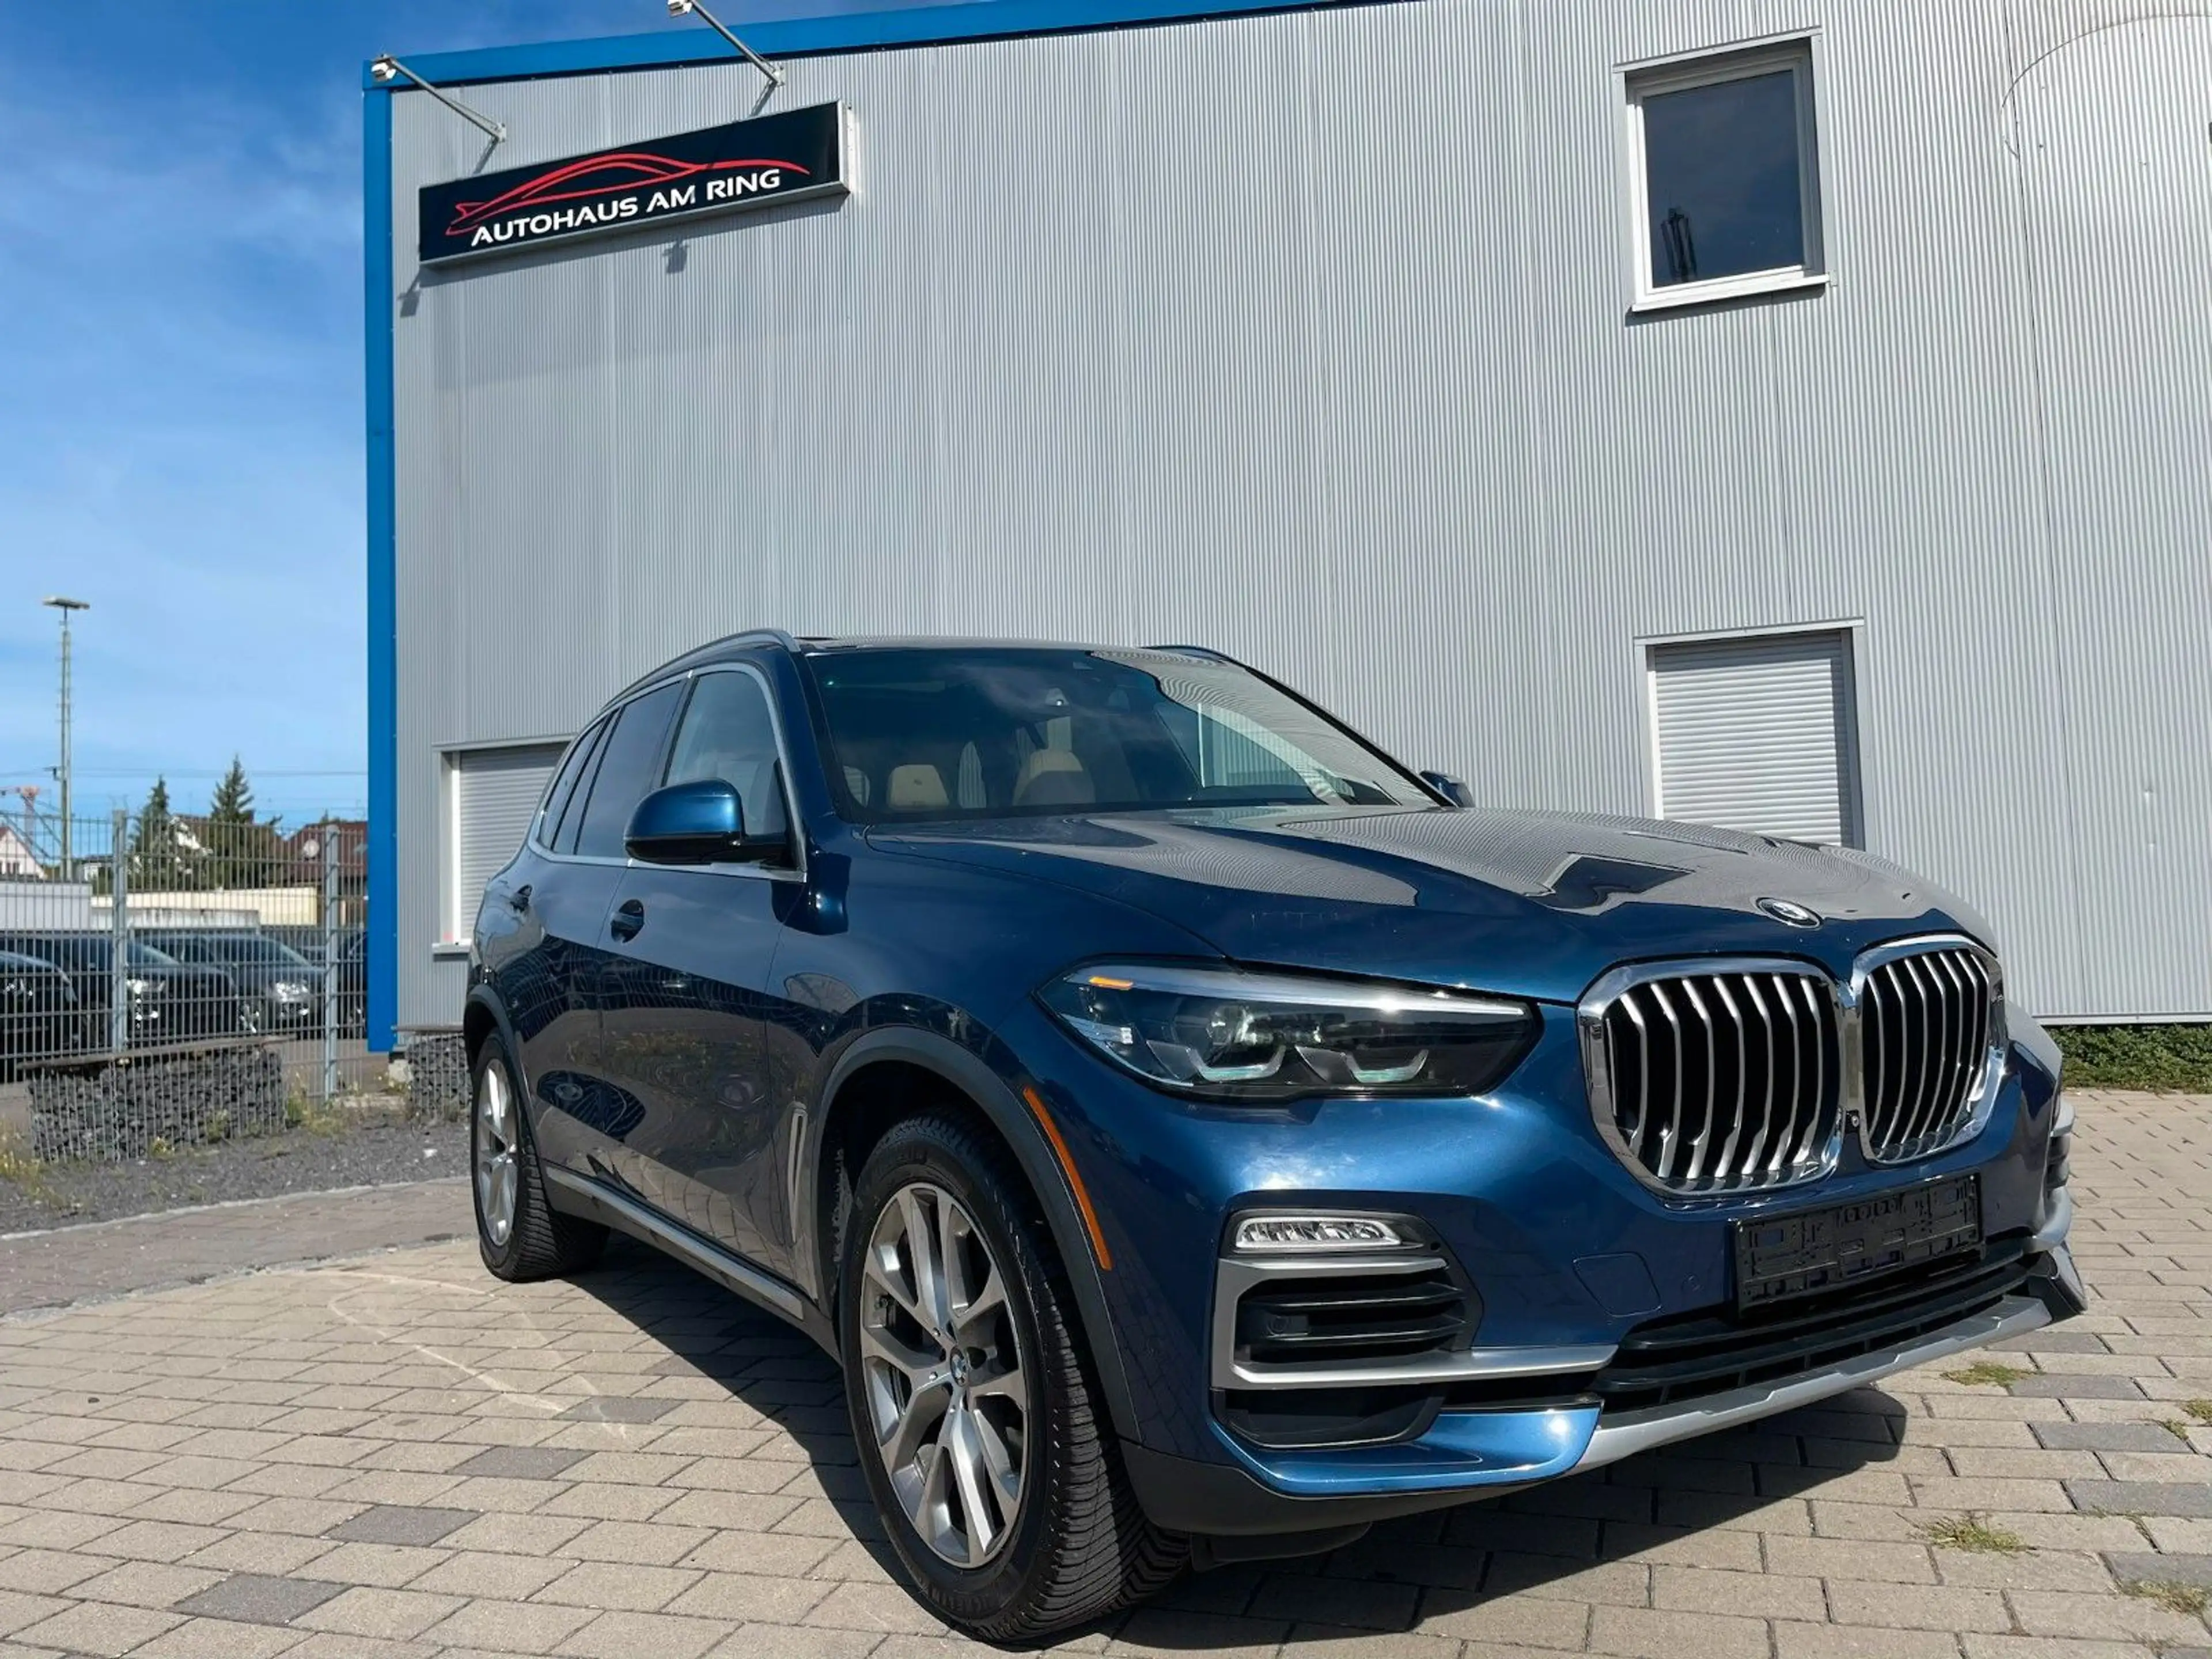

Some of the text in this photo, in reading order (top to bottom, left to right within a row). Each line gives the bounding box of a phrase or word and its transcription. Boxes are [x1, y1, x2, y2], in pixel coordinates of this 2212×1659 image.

[471, 169, 781, 247] AUTOHAUS AM RING
